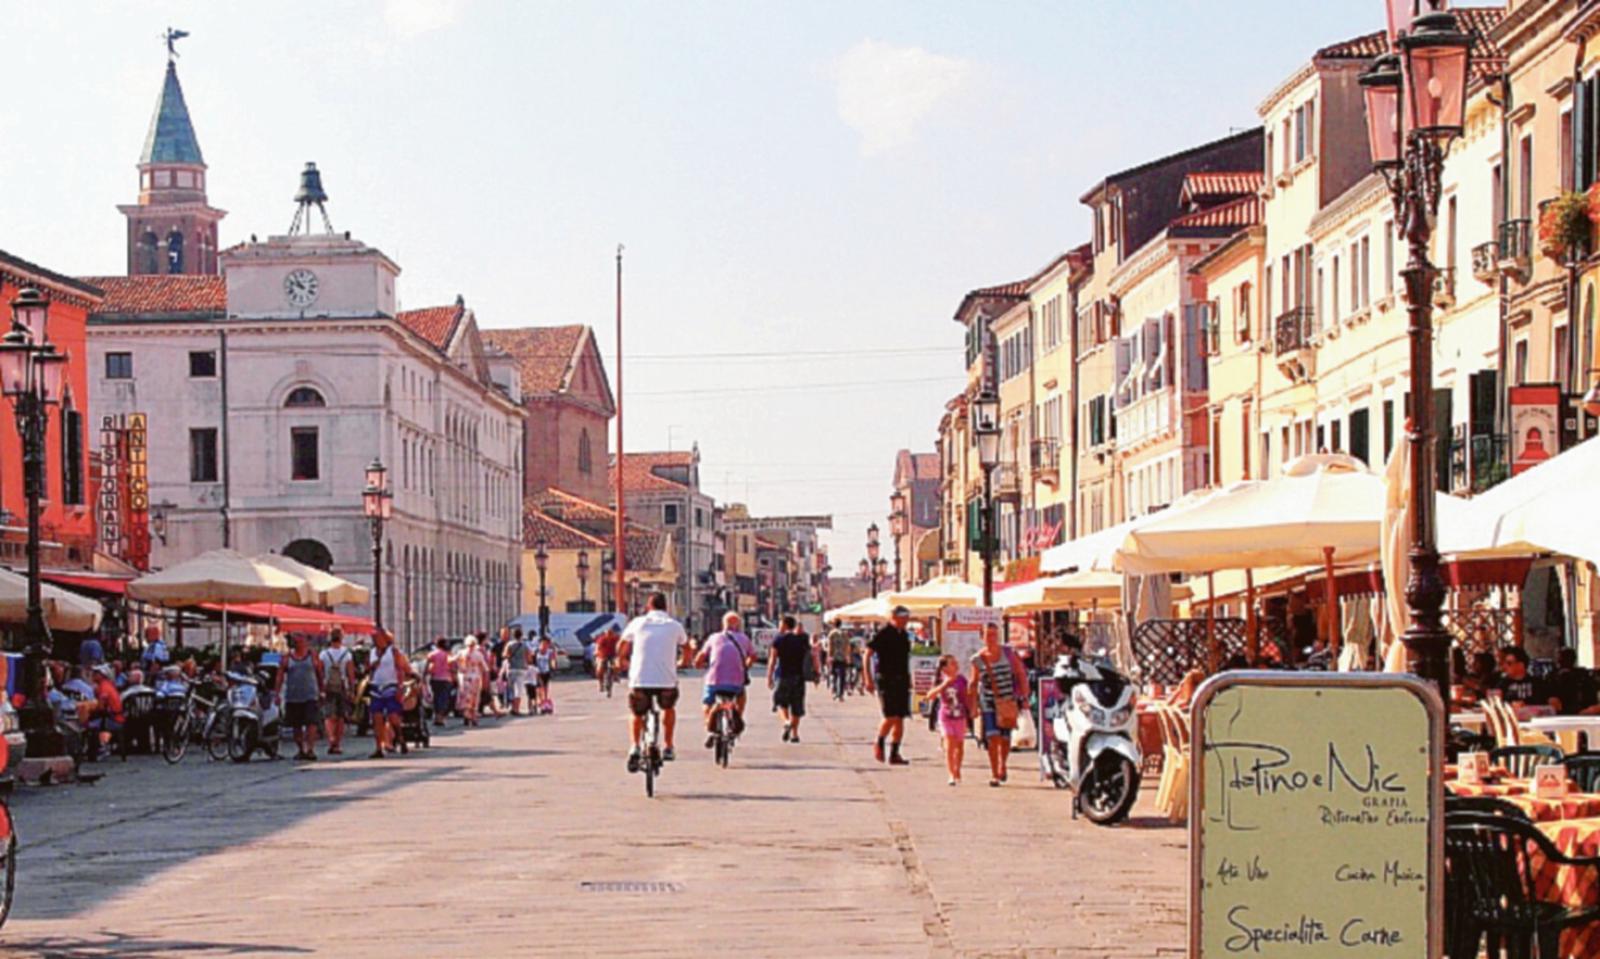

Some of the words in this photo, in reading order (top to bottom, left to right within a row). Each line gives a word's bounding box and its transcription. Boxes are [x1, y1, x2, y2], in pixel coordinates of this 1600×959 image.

[132, 415, 144, 509] ANTICO
[1313, 773, 1323, 787] e
[1329, 742, 1406, 793] Nic
[1340, 918, 1402, 946] Carne
